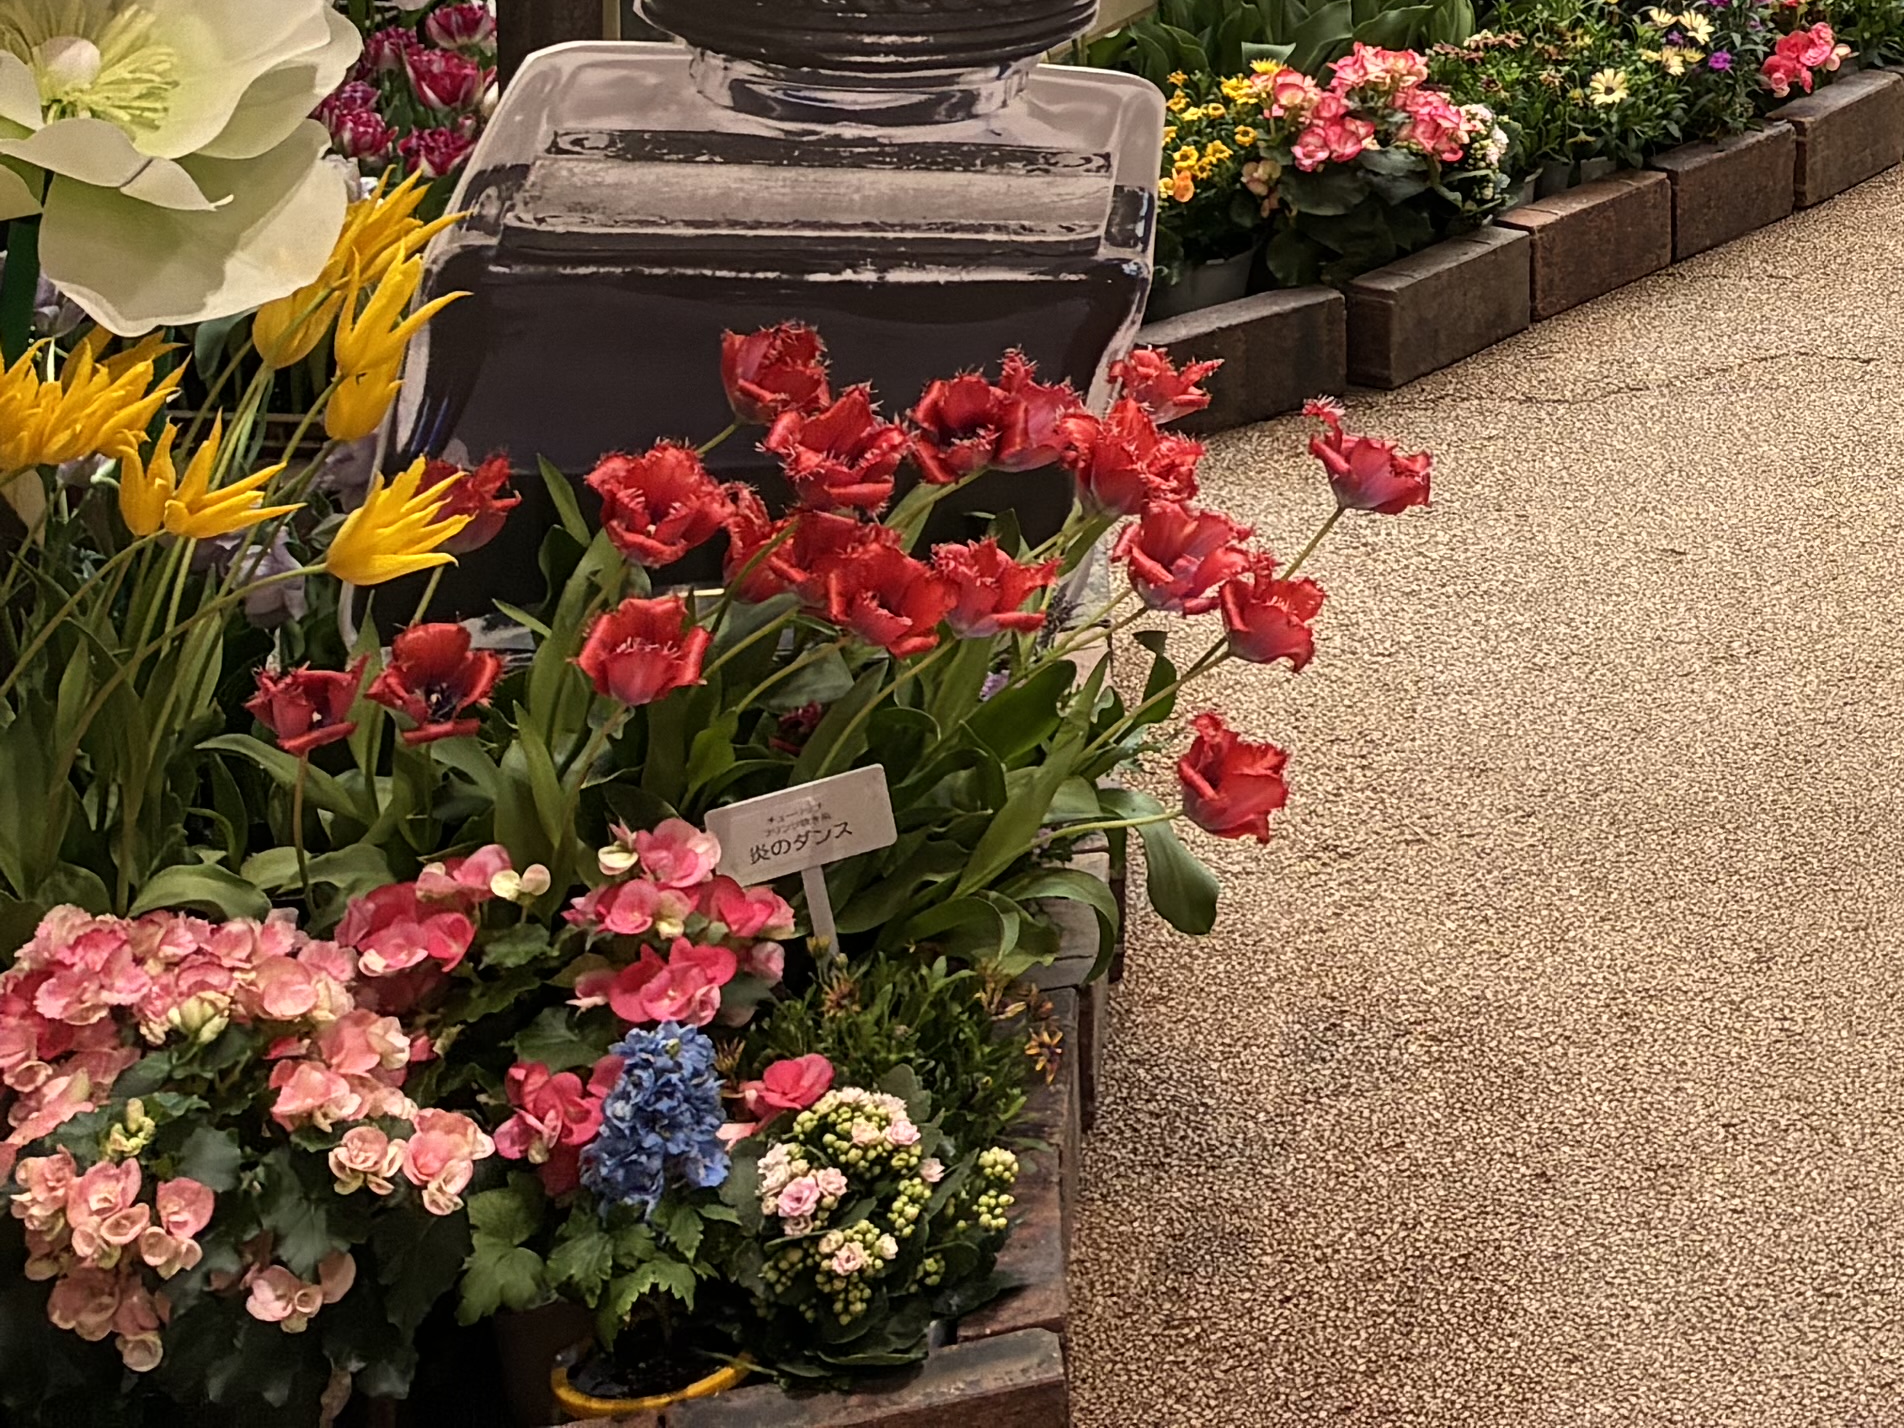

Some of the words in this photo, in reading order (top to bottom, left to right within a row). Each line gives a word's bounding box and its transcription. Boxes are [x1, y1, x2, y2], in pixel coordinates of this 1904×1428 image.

[750, 821, 853, 865] 炎のダンス
